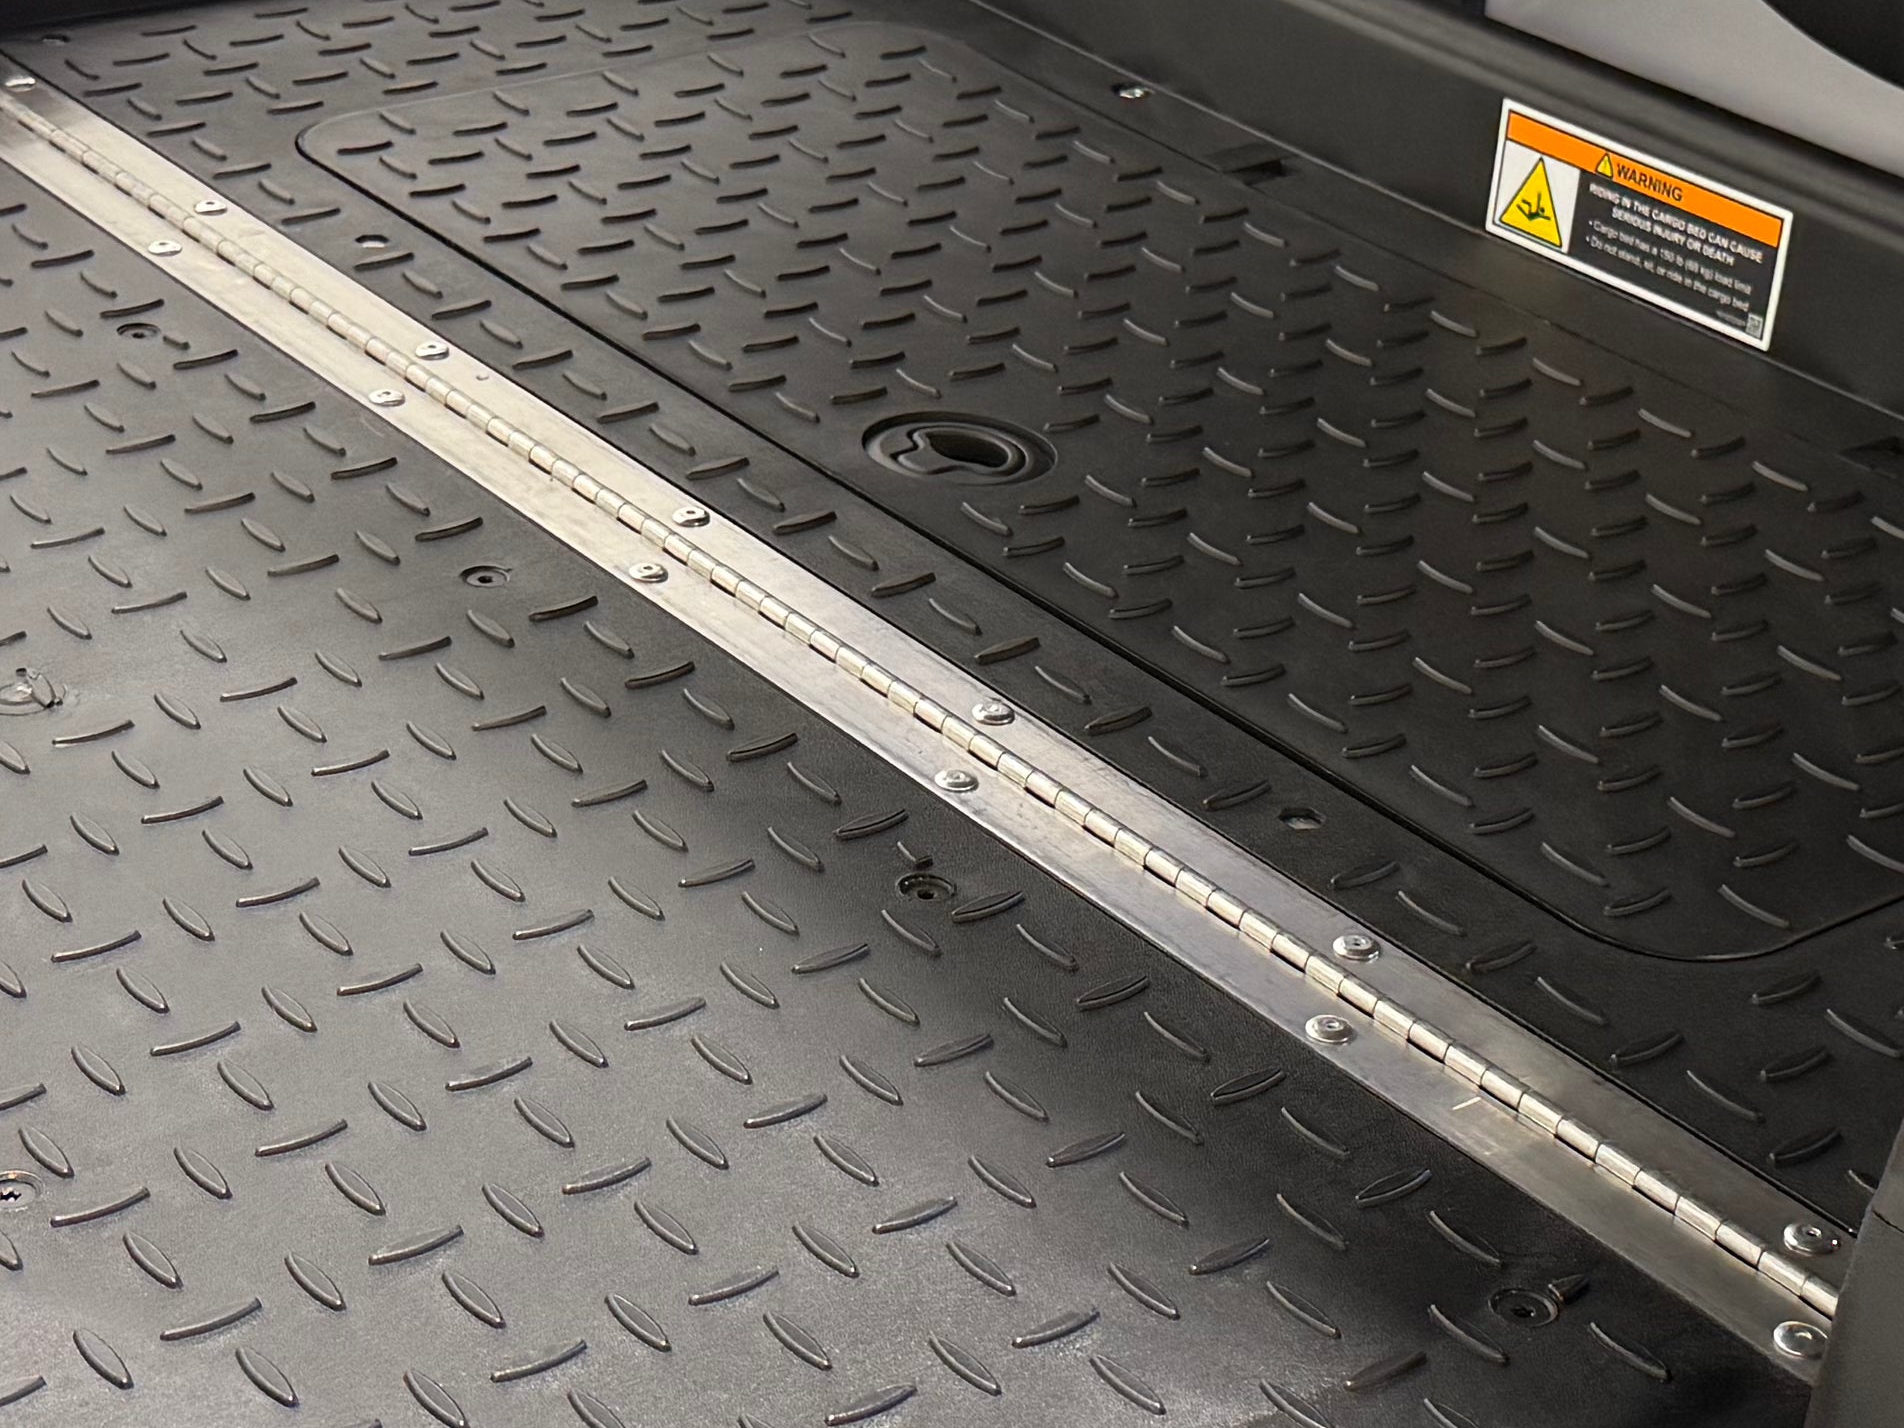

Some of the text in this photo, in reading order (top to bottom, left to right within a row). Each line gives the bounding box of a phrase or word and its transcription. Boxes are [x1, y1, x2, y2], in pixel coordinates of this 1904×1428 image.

[1615, 163, 1683, 202] WARNING
[1588, 182, 1764, 264] RIDING IN THE CARGO BED CAN CAUSE
[1589, 235, 1603, 250] Do
[1592, 220, 1618, 242] Cargo
[1611, 206, 1735, 267] SERIOUS INJURY OR DEATH
